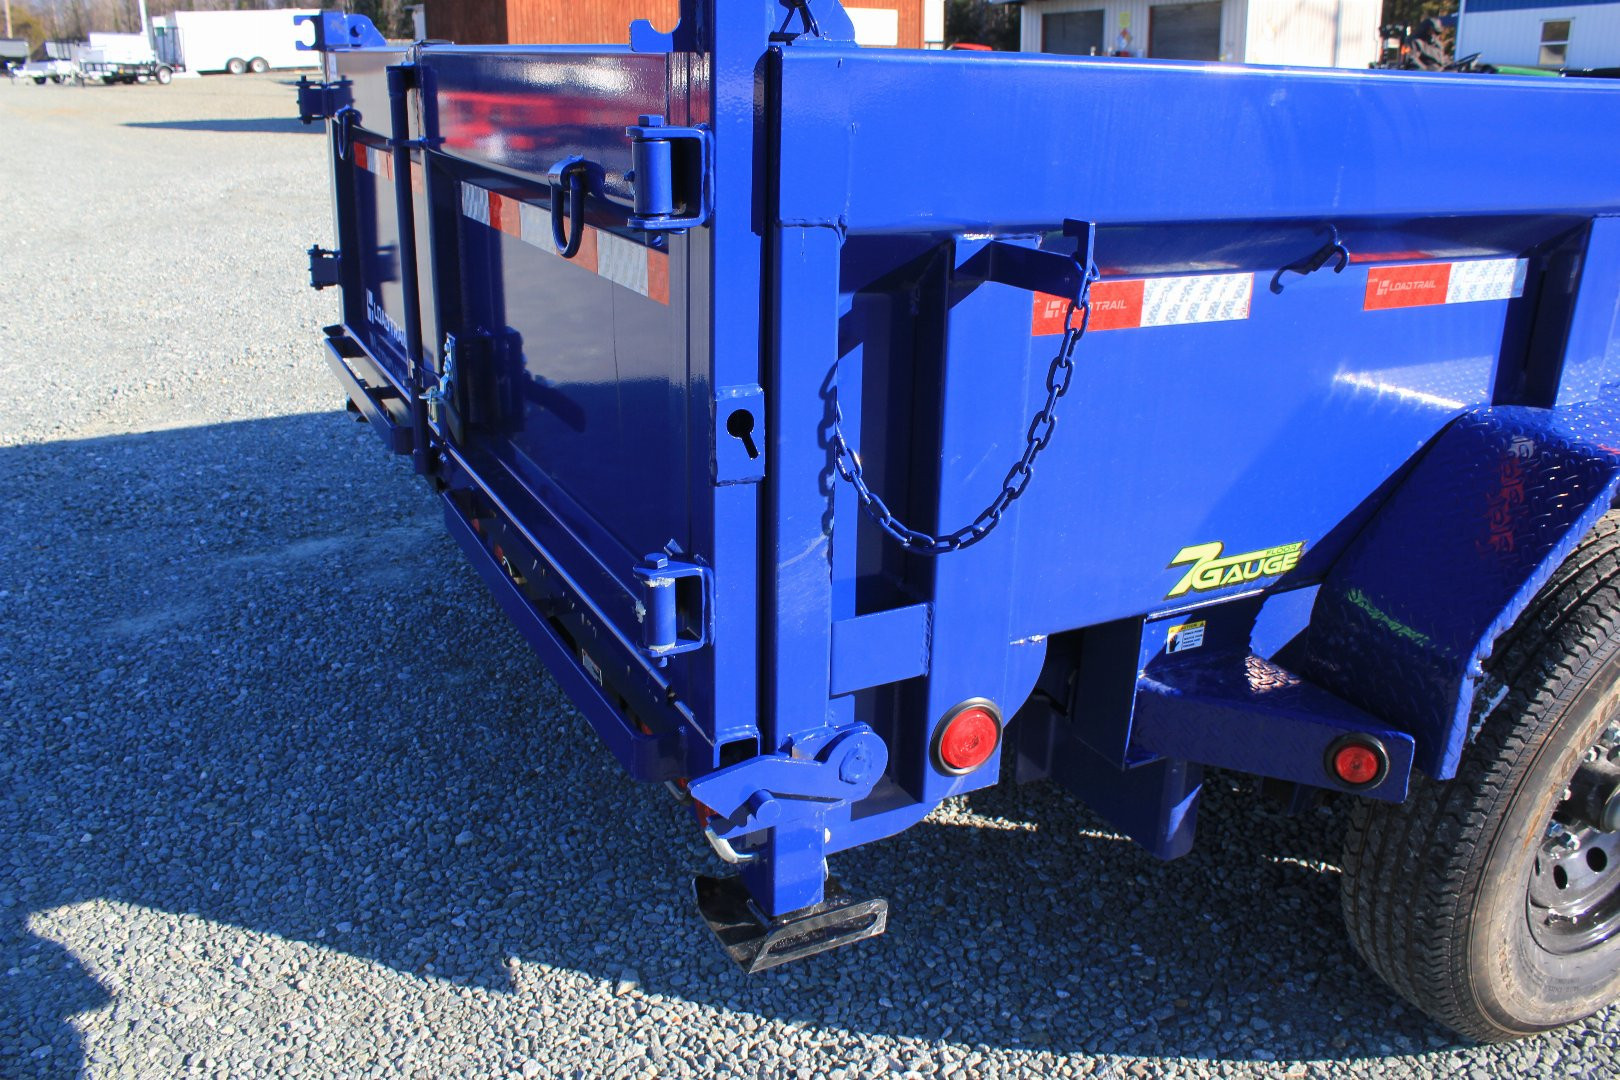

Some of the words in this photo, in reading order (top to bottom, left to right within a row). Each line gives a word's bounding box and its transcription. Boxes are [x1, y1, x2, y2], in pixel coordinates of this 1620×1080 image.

[1412, 280, 1436, 289] TRAIL
[1095, 300, 1127, 311] TRAIL
[1265, 544, 1297, 556] FLOOR
[1166, 541, 1224, 600] 7
[1191, 551, 1301, 591] GAUGE
